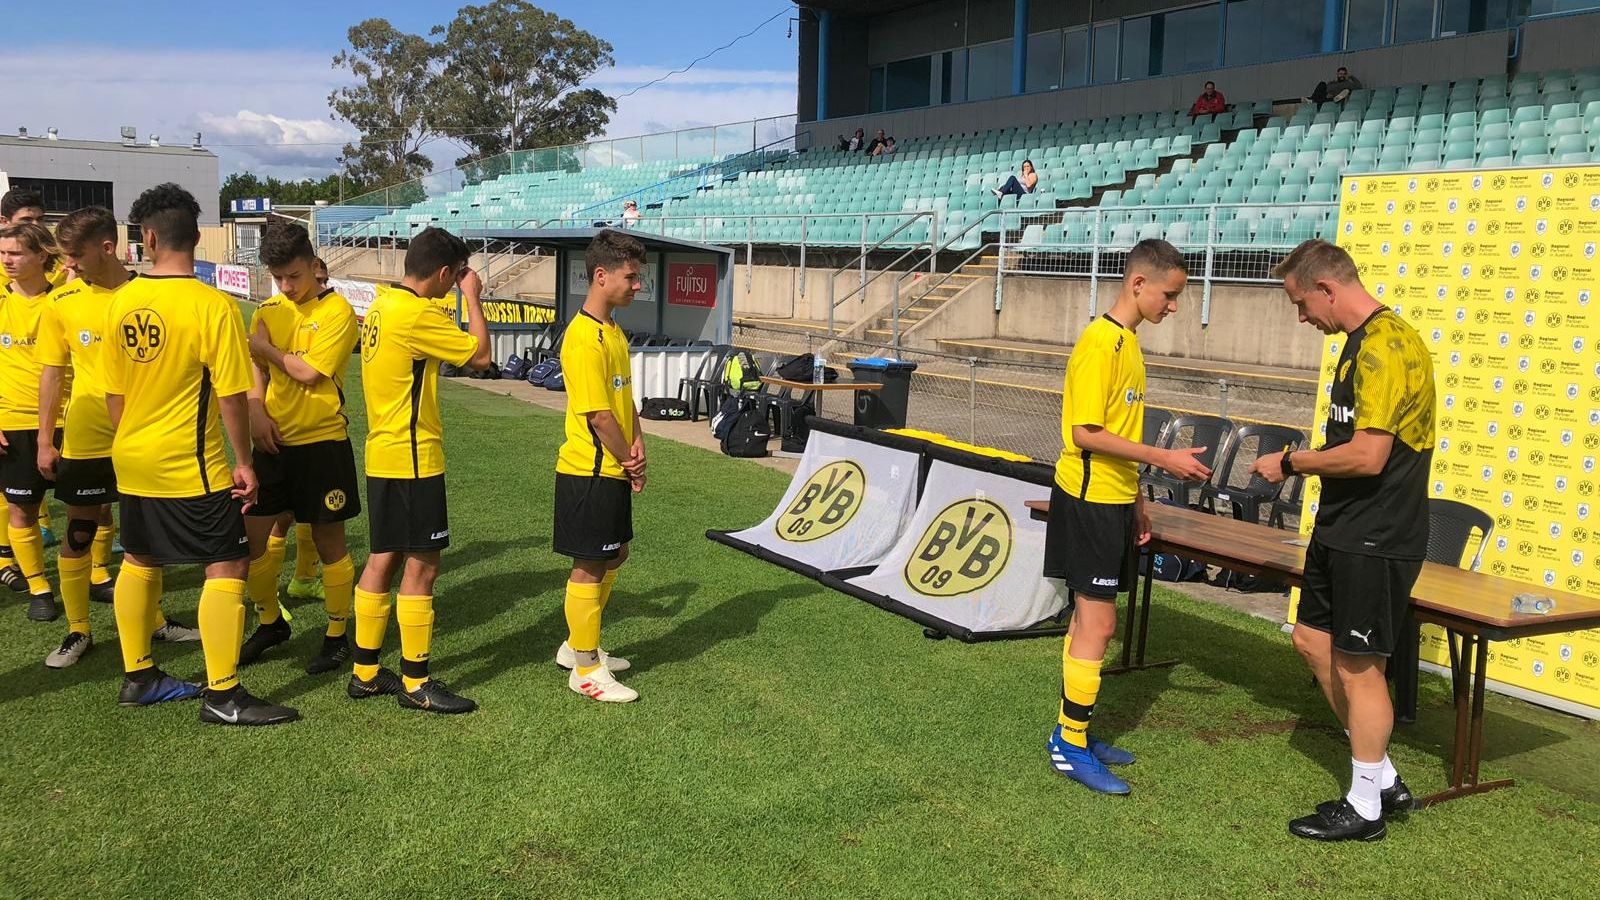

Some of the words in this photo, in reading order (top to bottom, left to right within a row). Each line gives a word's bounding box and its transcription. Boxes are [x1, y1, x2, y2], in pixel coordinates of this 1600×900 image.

[1493, 177, 1506, 186] BVB
[1565, 174, 1579, 183] BVB
[1468, 200, 1480, 209] BVB
[1538, 198, 1551, 207] BVB
[1488, 222, 1500, 230] BVB
[1560, 221, 1573, 230] BVB
[1463, 244, 1475, 253] BVB
[1532, 244, 1545, 253] BVB
[1482, 266, 1494, 275] BVB
[1554, 268, 1567, 277] BVB
[676, 276, 707, 297] FUJITSU
[1458, 288, 1469, 297] BVB
[1526, 290, 1539, 299] BVB
[1476, 310, 1489, 320] BVB
[1548, 314, 1561, 324] BVB
[123, 313, 161, 348] BVB
[1452, 331, 1464, 340] BVB
[1520, 335, 1533, 345] BVB
[1471, 355, 1483, 364] BVB
[1542, 360, 1555, 370] BVB
[1447, 374, 1458, 384] BVB
[1515, 381, 1528, 391] BVB
[1466, 398, 1478, 408] BVB
[1536, 406, 1549, 416] BVB
[1441, 418, 1453, 427] BVB
[1509, 426, 1522, 436] BVB
[1585, 434, 1599, 445] BVB
[1460, 442, 1472, 452] BVB
[1530, 451, 1544, 462] BVB
[1436, 460, 1448, 471] BVB
[1504, 470, 1516, 481] BVB
[5, 487, 32, 495] LEGEA
[1455, 485, 1467, 496] BVB
[1579, 481, 1593, 492] BVB
[76, 488, 106, 496] LEGEA
[790, 468, 854, 525] BVB
[329, 491, 344, 505] BVB
[1525, 496, 1538, 508] BVB
[1498, 515, 1511, 526] BVB
[787, 517, 813, 536] 09
[919, 506, 1000, 579] BVB
[1493, 561, 1506, 572] BVB
[920, 565, 952, 589] 09
[1568, 576, 1581, 588] BVB
